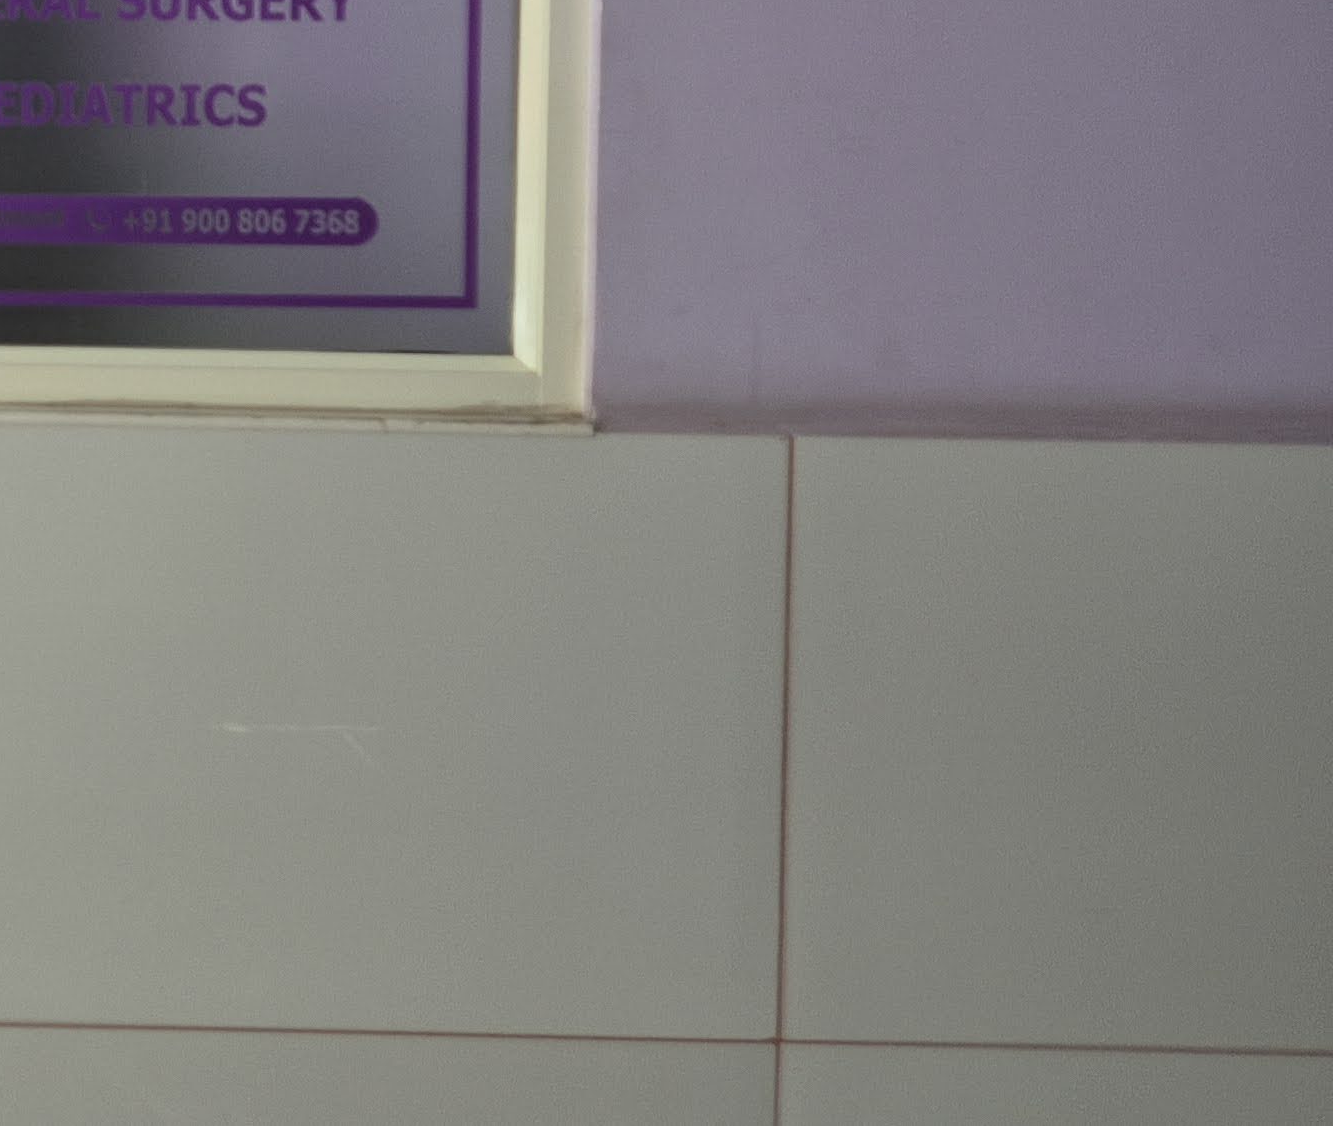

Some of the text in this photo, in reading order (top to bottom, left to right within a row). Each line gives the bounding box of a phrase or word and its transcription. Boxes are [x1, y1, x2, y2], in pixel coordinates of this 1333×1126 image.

[180, 208, 231, 235] 900
[237, 208, 287, 235] 806
[294, 209, 360, 235] 7368
